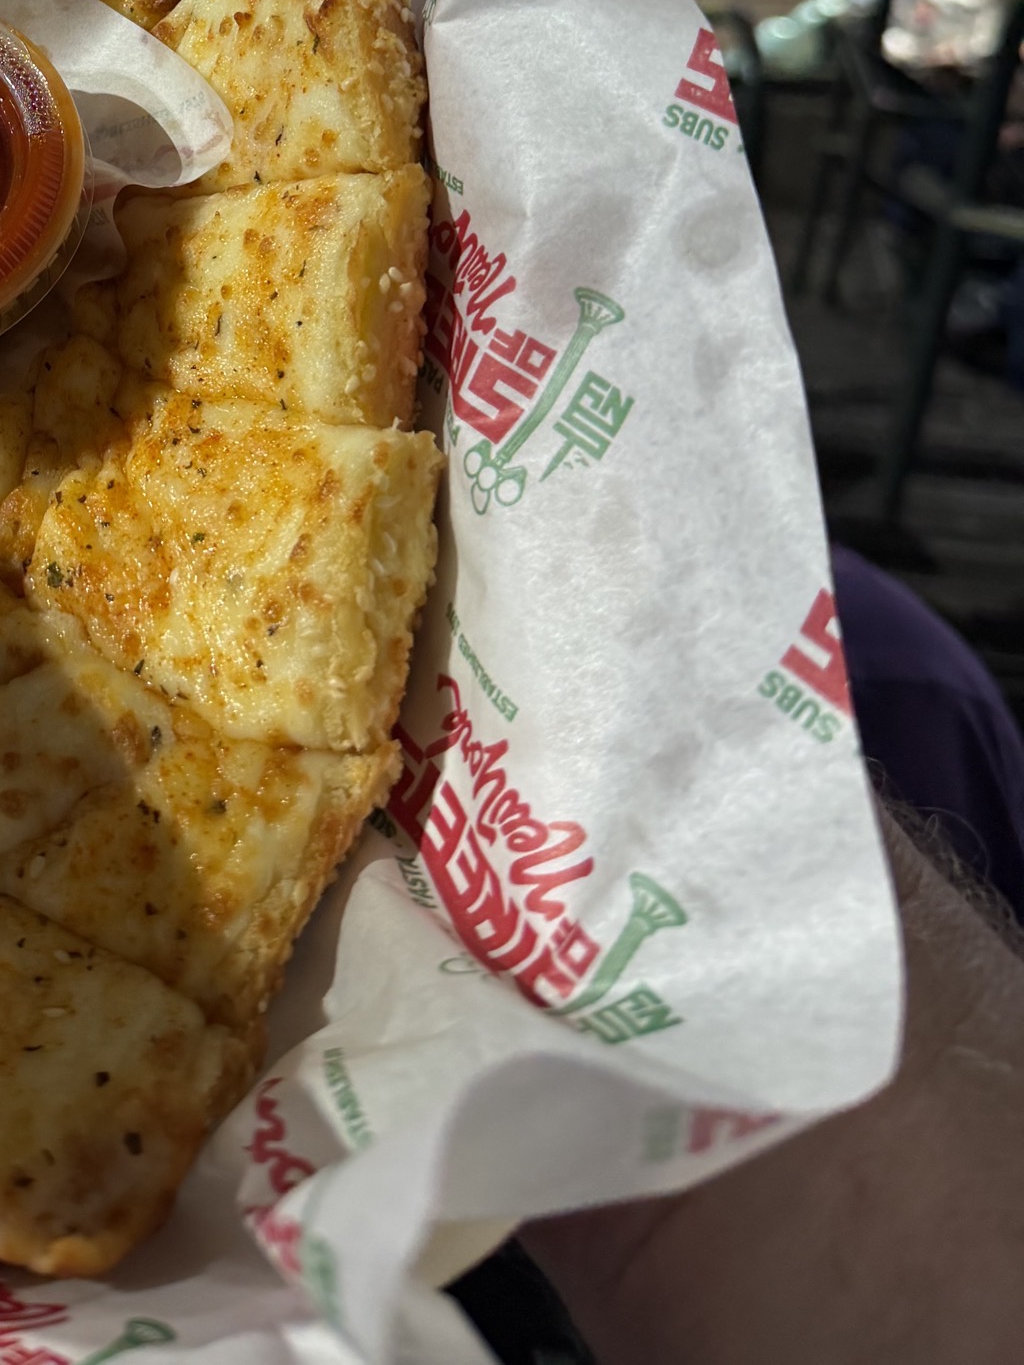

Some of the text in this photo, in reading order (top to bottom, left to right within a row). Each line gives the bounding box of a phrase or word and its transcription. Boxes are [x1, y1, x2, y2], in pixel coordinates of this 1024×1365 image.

[662, 103, 729, 151] SUBS
[488, 327, 557, 382] OF
[757, 671, 844, 744] SUBS
[396, 854, 437, 910] PASTA
[551, 916, 601, 979] OF
